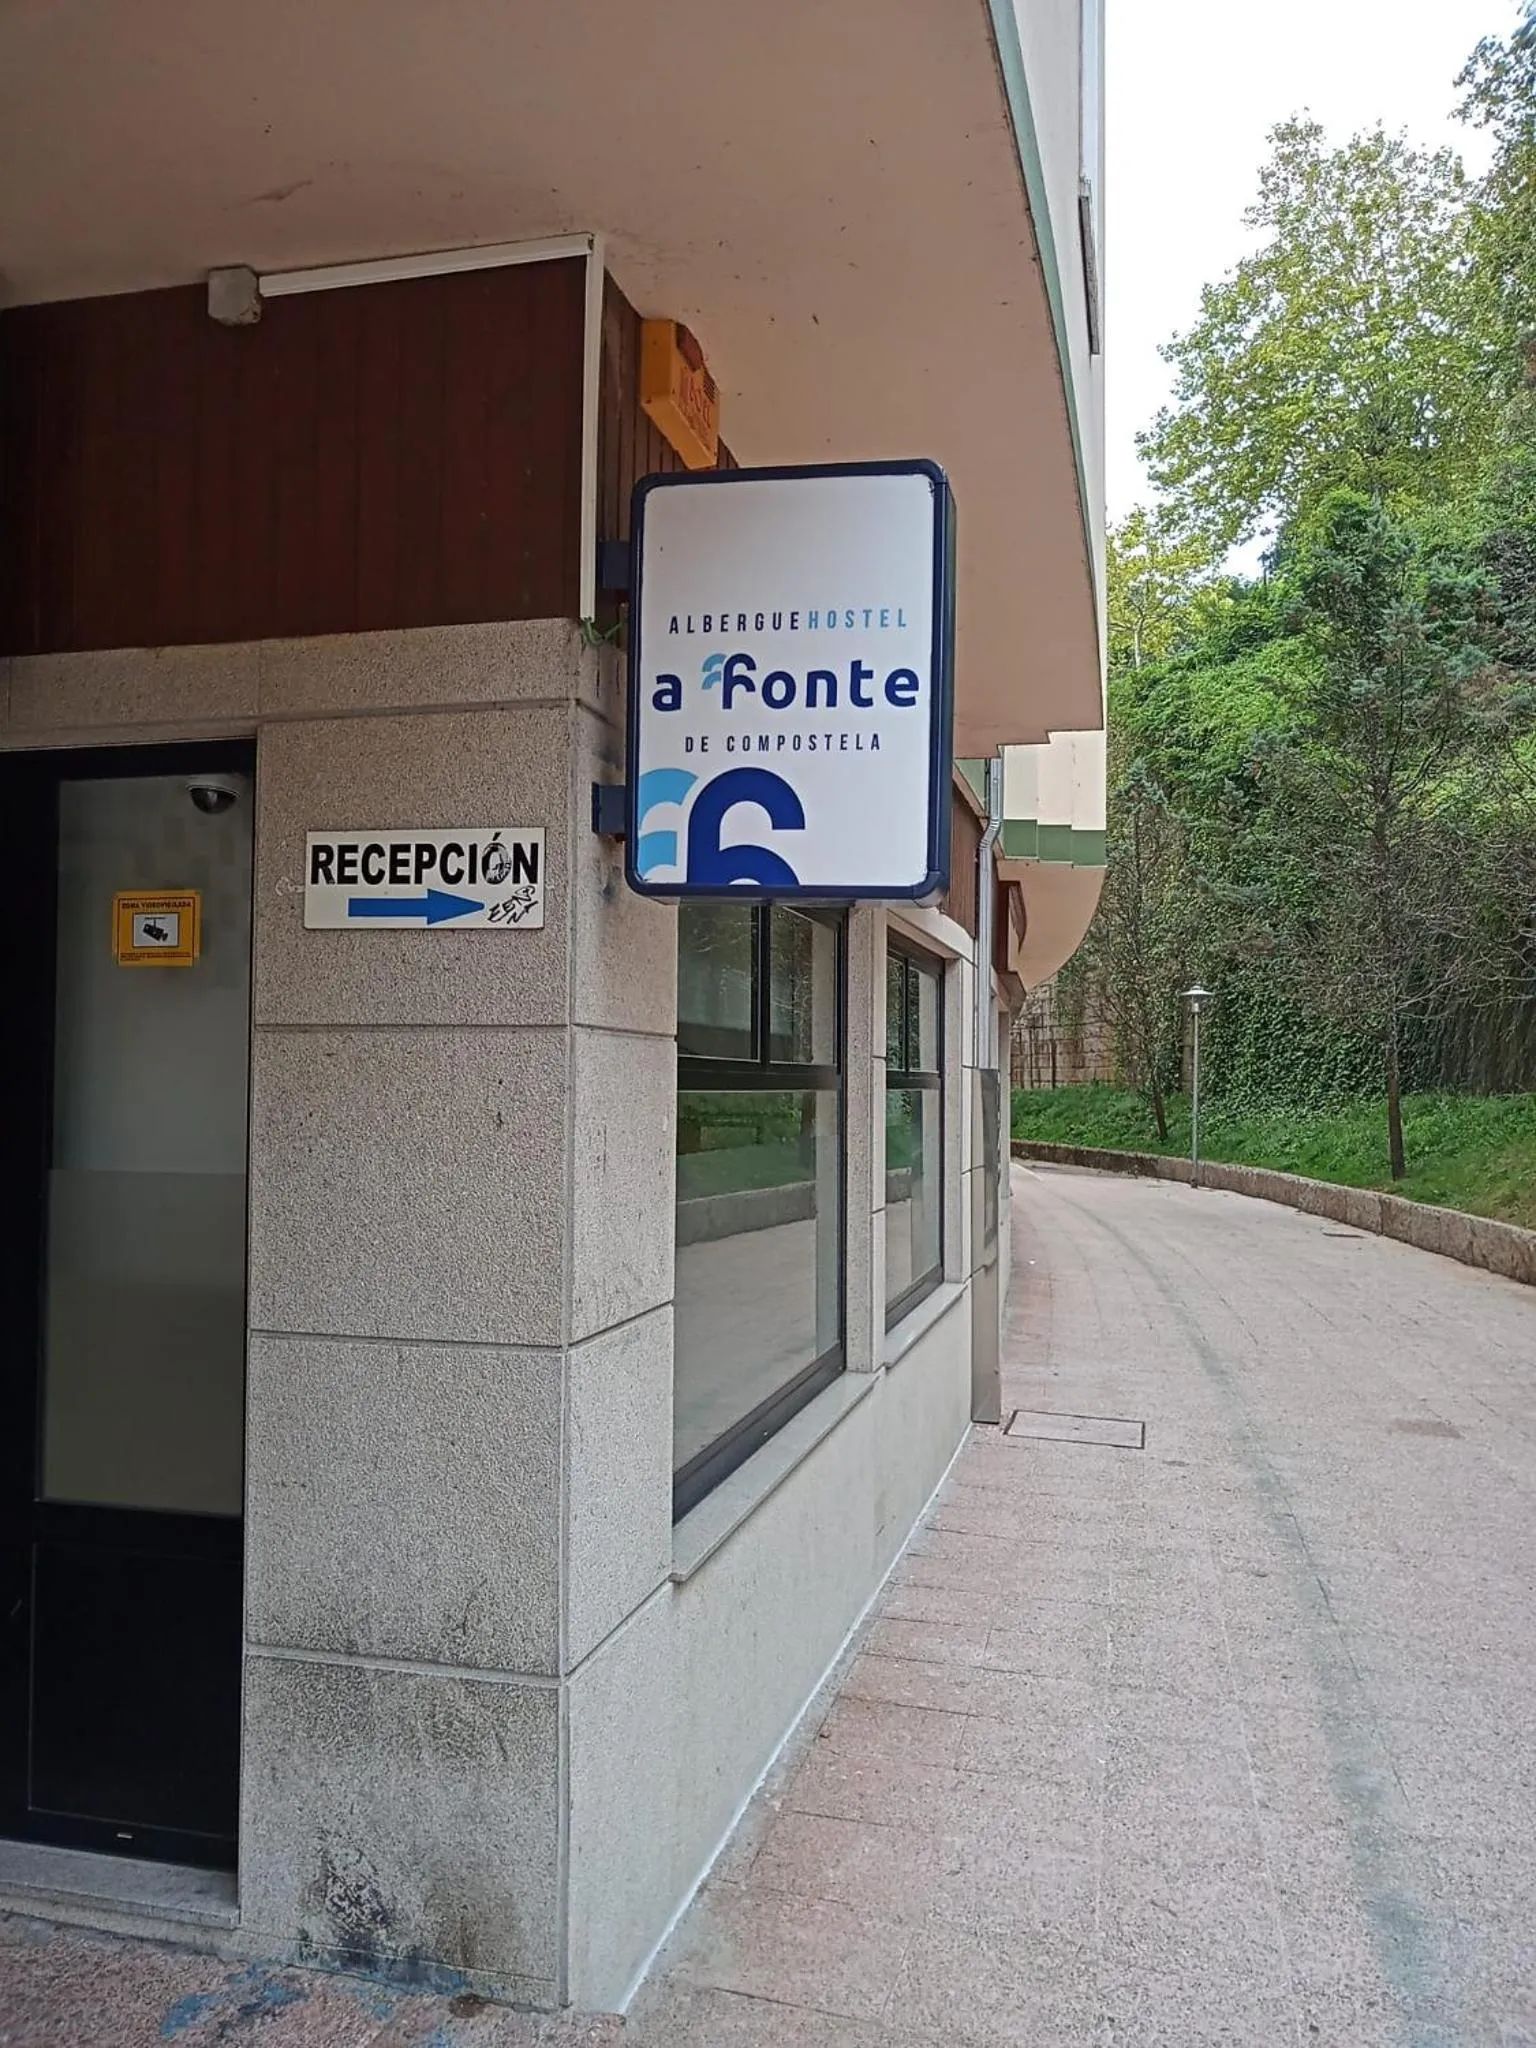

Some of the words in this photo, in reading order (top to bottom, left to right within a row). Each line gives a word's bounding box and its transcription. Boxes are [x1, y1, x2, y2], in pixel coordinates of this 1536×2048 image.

[669, 611, 800, 634] ALBERGUE
[808, 608, 908, 629] HOSTEL
[652, 673, 682, 711] a
[722, 653, 919, 710] fonte
[685, 735, 709, 753] DE
[726, 733, 881, 752] COMPOSTELA
[310, 832, 539, 885] RECEPCIÓN
